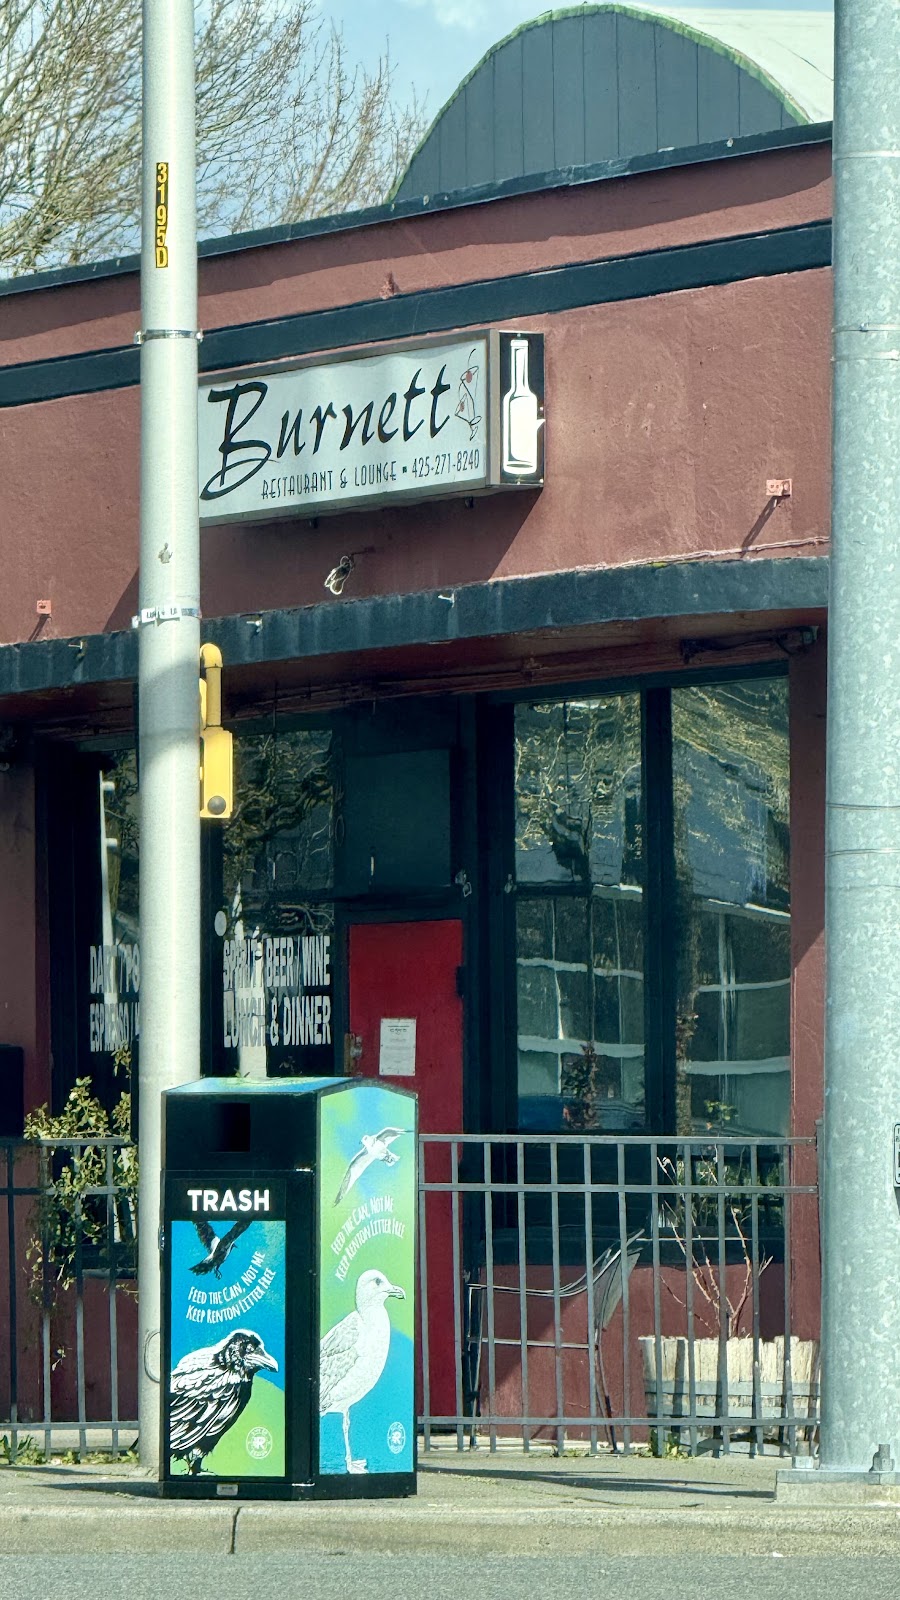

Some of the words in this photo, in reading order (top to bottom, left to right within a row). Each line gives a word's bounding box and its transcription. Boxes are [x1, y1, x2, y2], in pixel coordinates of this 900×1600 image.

[156, 162, 168, 268] 3195D
[199, 364, 451, 500] Burnett
[261, 470, 333, 499] RESTAURANT
[339, 468, 348, 488] &
[354, 461, 397, 487] LOUNGE
[411, 448, 480, 478] 425-271-8240
[266, 937, 294, 987] BEER
[302, 935, 331, 986] WINE
[223, 997, 265, 1048] LUNCH
[270, 996, 280, 1047] &
[283, 995, 332, 1046] DINNER
[187, 1189, 270, 1212] TRASH
[331, 1232, 346, 1255] FEED
[342, 1216, 356, 1236] THE
[370, 1196, 384, 1214] NOT
[384, 1194, 394, 1213] ME
[335, 1255, 350, 1281] KEEP
[345, 1225, 371, 1260] RENTON
[369, 1218, 391, 1236] LITTER
[392, 1217, 405, 1239] FREE
[186, 1305, 206, 1323] KEEP
[207, 1304, 240, 1324] RENTON
[239, 1285, 265, 1313] LITTER
[258, 1267, 276, 1289] FREE
[188, 1286, 207, 1304] FEED
[208, 1291, 223, 1304] THE
[222, 1282, 246, 1302] CAN,
[241, 1265, 259, 1286] NOT
[251, 1251, 266, 1267] ME
